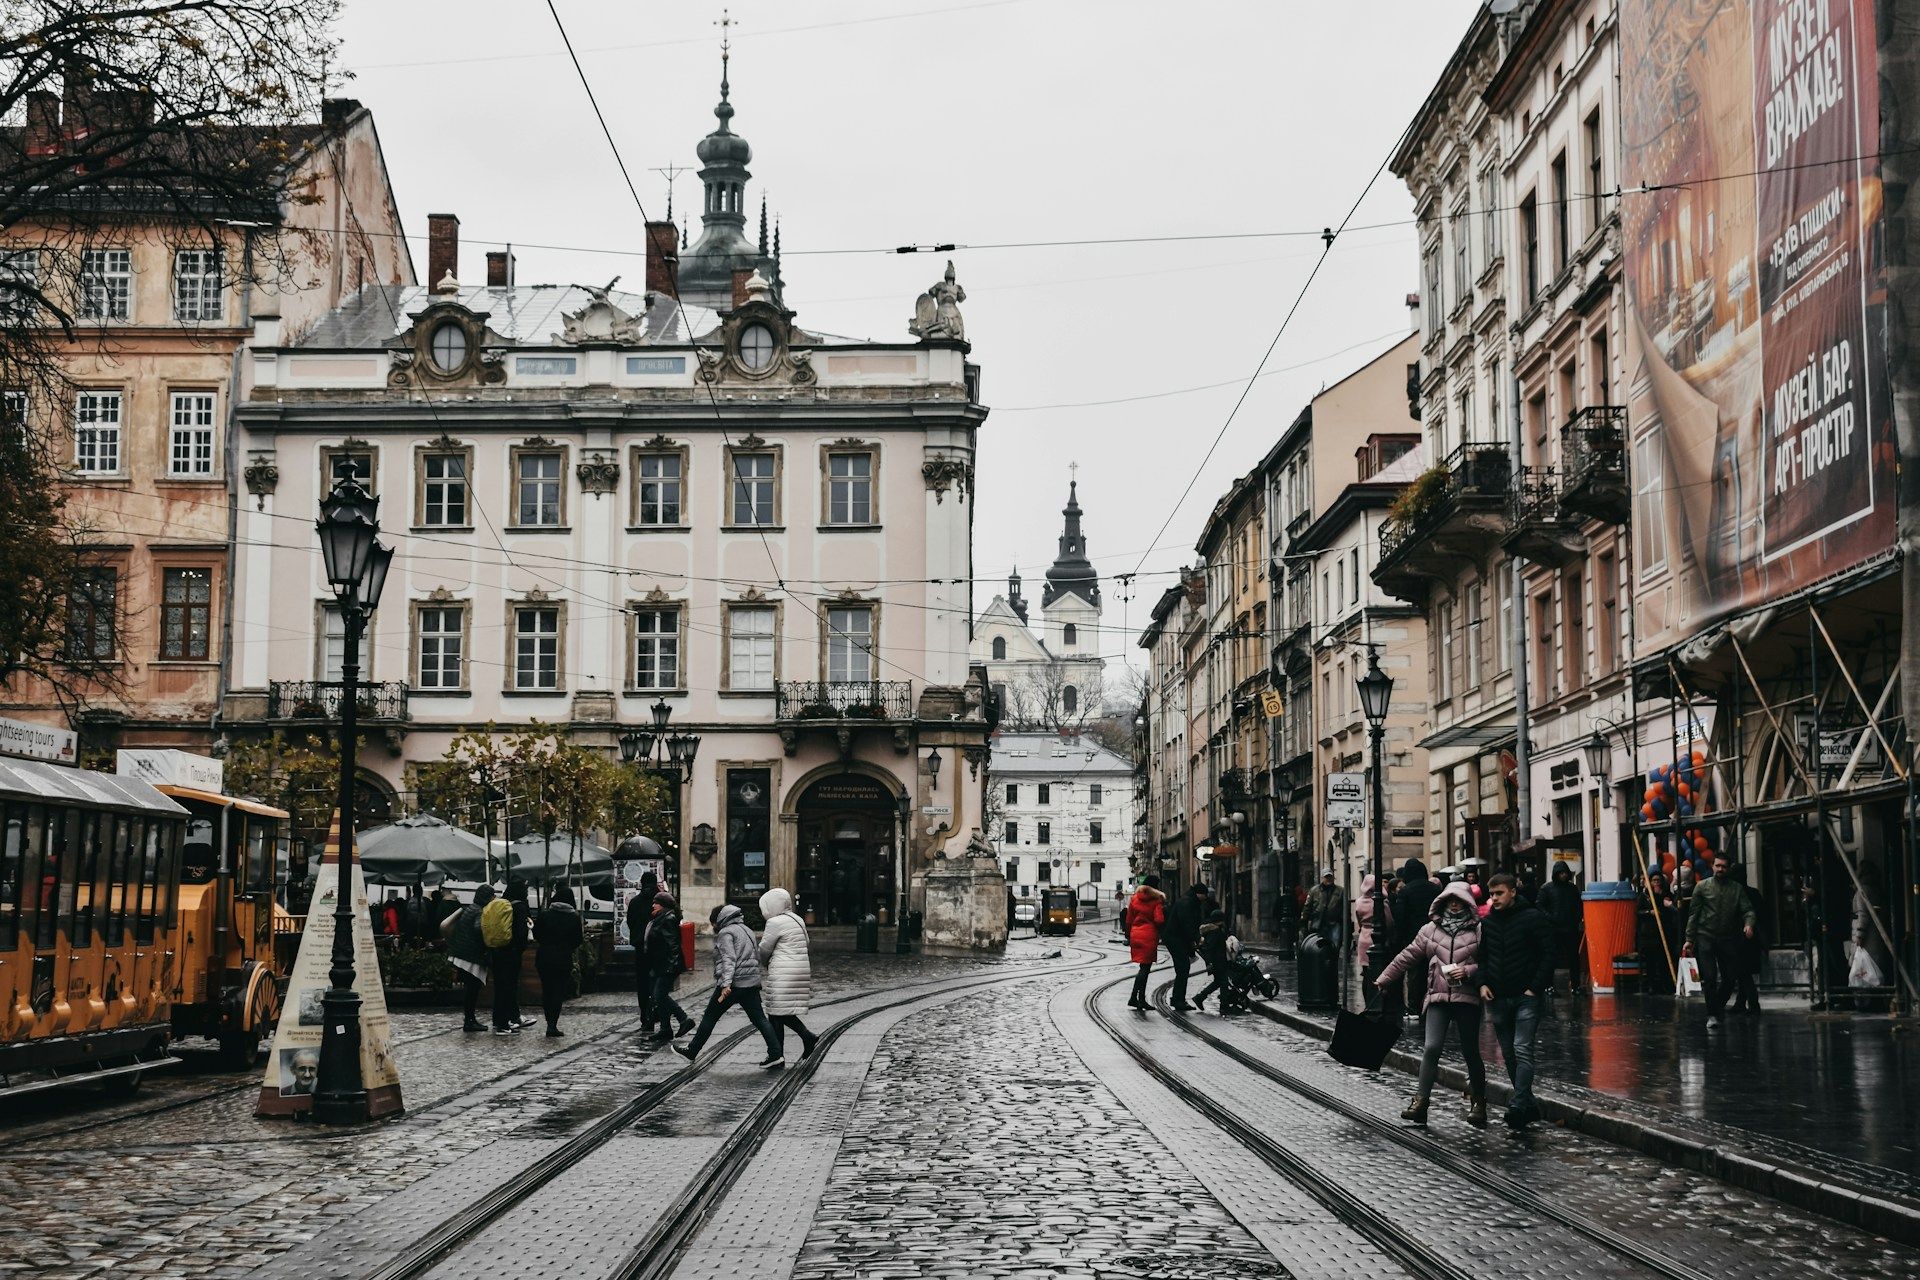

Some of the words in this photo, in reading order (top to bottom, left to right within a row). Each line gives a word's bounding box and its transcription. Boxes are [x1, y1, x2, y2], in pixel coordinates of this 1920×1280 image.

[1765, 27, 1844, 170] ВРАЖАЄ!
[1797, 236, 1829, 272] ОПЕРНОГО
[1799, 186, 1841, 245] ПІШКИ
[1774, 352, 1822, 438] МУЗЕЙ.
[1822, 339, 1853, 404] БАР.
[1774, 401, 1855, 496] АРТ-ПРОСТІР
[35, 730, 55, 747] tours
